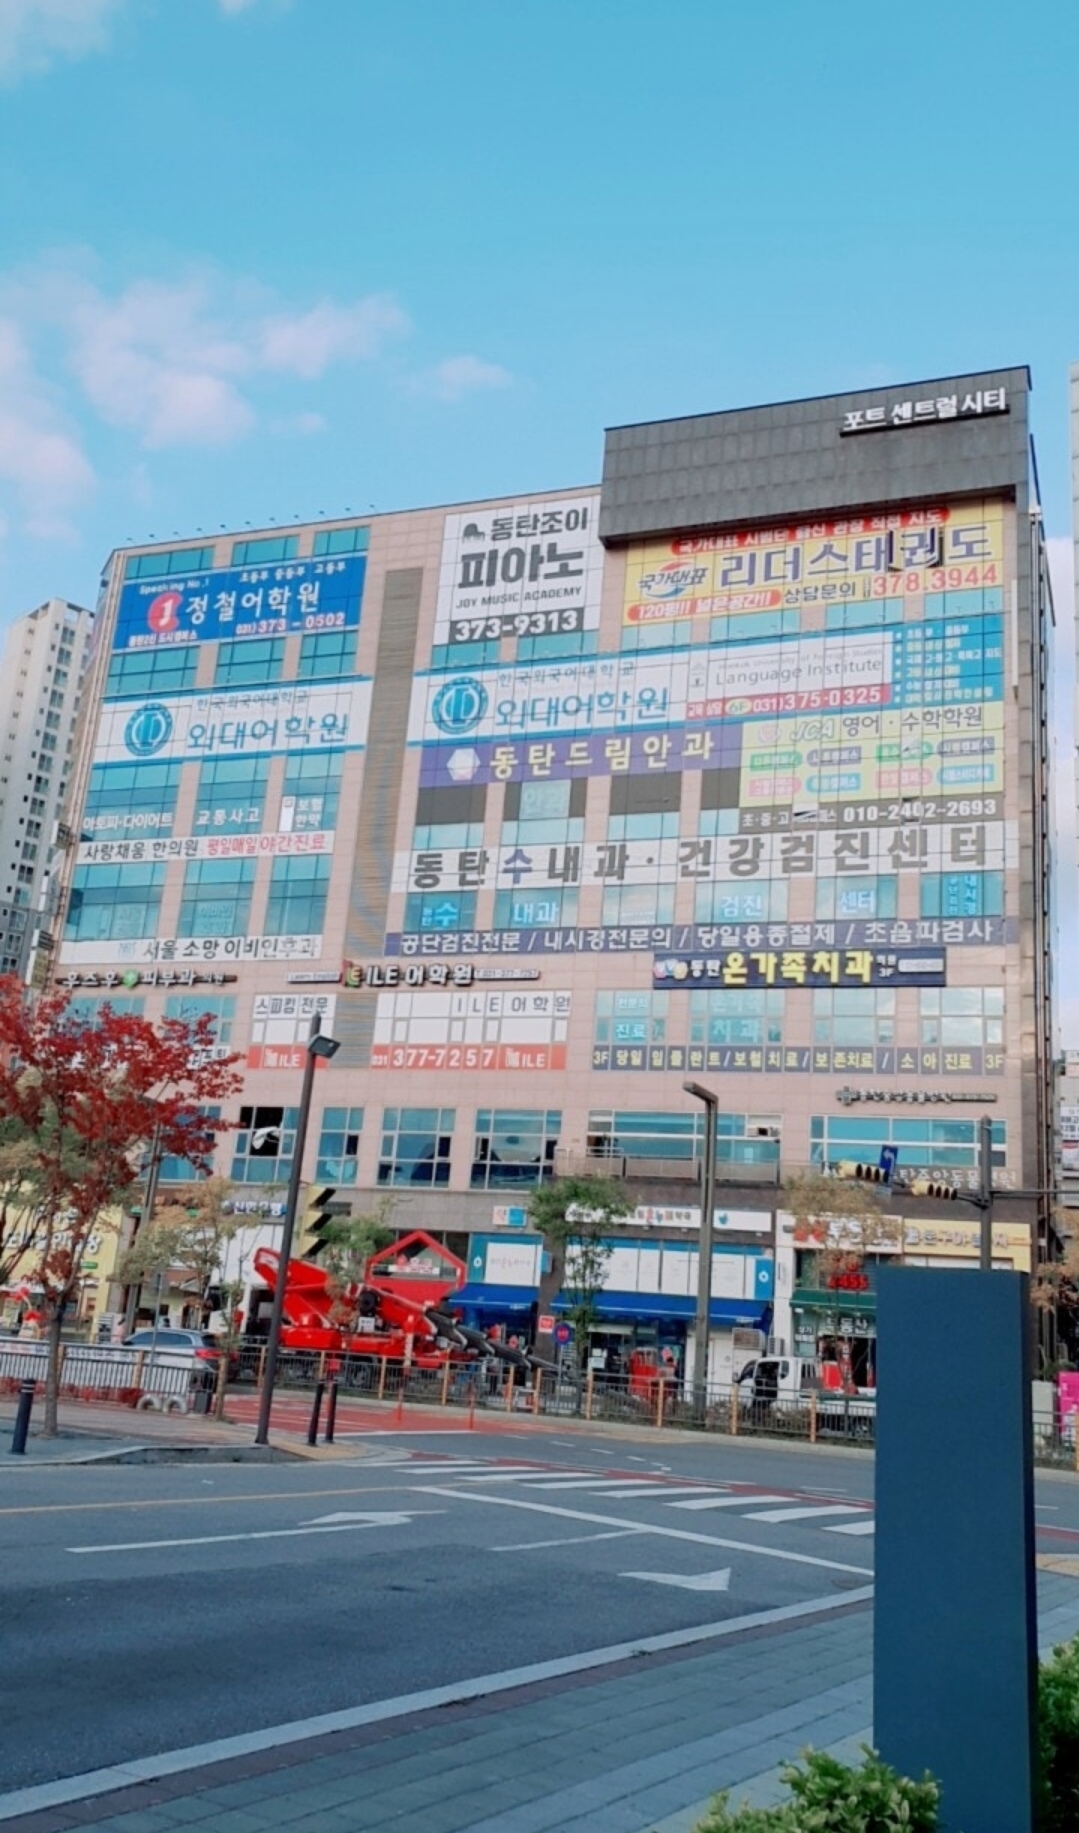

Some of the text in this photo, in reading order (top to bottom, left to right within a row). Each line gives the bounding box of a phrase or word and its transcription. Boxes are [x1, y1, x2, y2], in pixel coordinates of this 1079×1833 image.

[843, 387, 1006, 431] 포트 센트럴 시티
[490, 507, 588, 541] 동탄조이
[458, 542, 584, 589] 피아노
[721, 526, 991, 588] 리더스태권도
[638, 567, 708, 590] 국가대표
[784, 582, 855, 604] 상담문의
[873, 563, 997, 597] 378.3944
[185, 581, 320, 625] 정철어학원
[455, 586, 582, 608] JOY MUSIC ACADEMY
[455, 610, 578, 641] 373-9313
[716, 666, 803, 687] Language
[808, 658, 883, 676] Institute
[495, 687, 668, 729] 외대어학원
[843, 715, 880, 737] 영어
[901, 706, 982, 732] 수학학원
[188, 713, 348, 751] 외대어학원
[490, 730, 715, 779] 동탄드림안과
[196, 807, 259, 827] 교통사고
[84, 842, 145, 861] 사랑채움
[152, 839, 199, 858] 한의원
[513, 902, 560, 924] 내과
[720, 894, 762, 917] 검진
[143, 941, 178, 961] 서울
[183, 940, 219, 960] 소망
[401, 930, 520, 955] 공단검진전문
[864, 919, 993, 944] 초음파검사
[142, 968, 197, 988] 피부과
[366, 963, 474, 986] ILE 어학원
[723, 950, 874, 985] 온가족치과
[457, 995, 571, 1014] ILE 어학원
[278, 1053, 300, 1068] ILE
[393, 1048, 494, 1068] 377-7257
[521, 1053, 546, 1068] ILE
[593, 1051, 609, 1066] 3F
